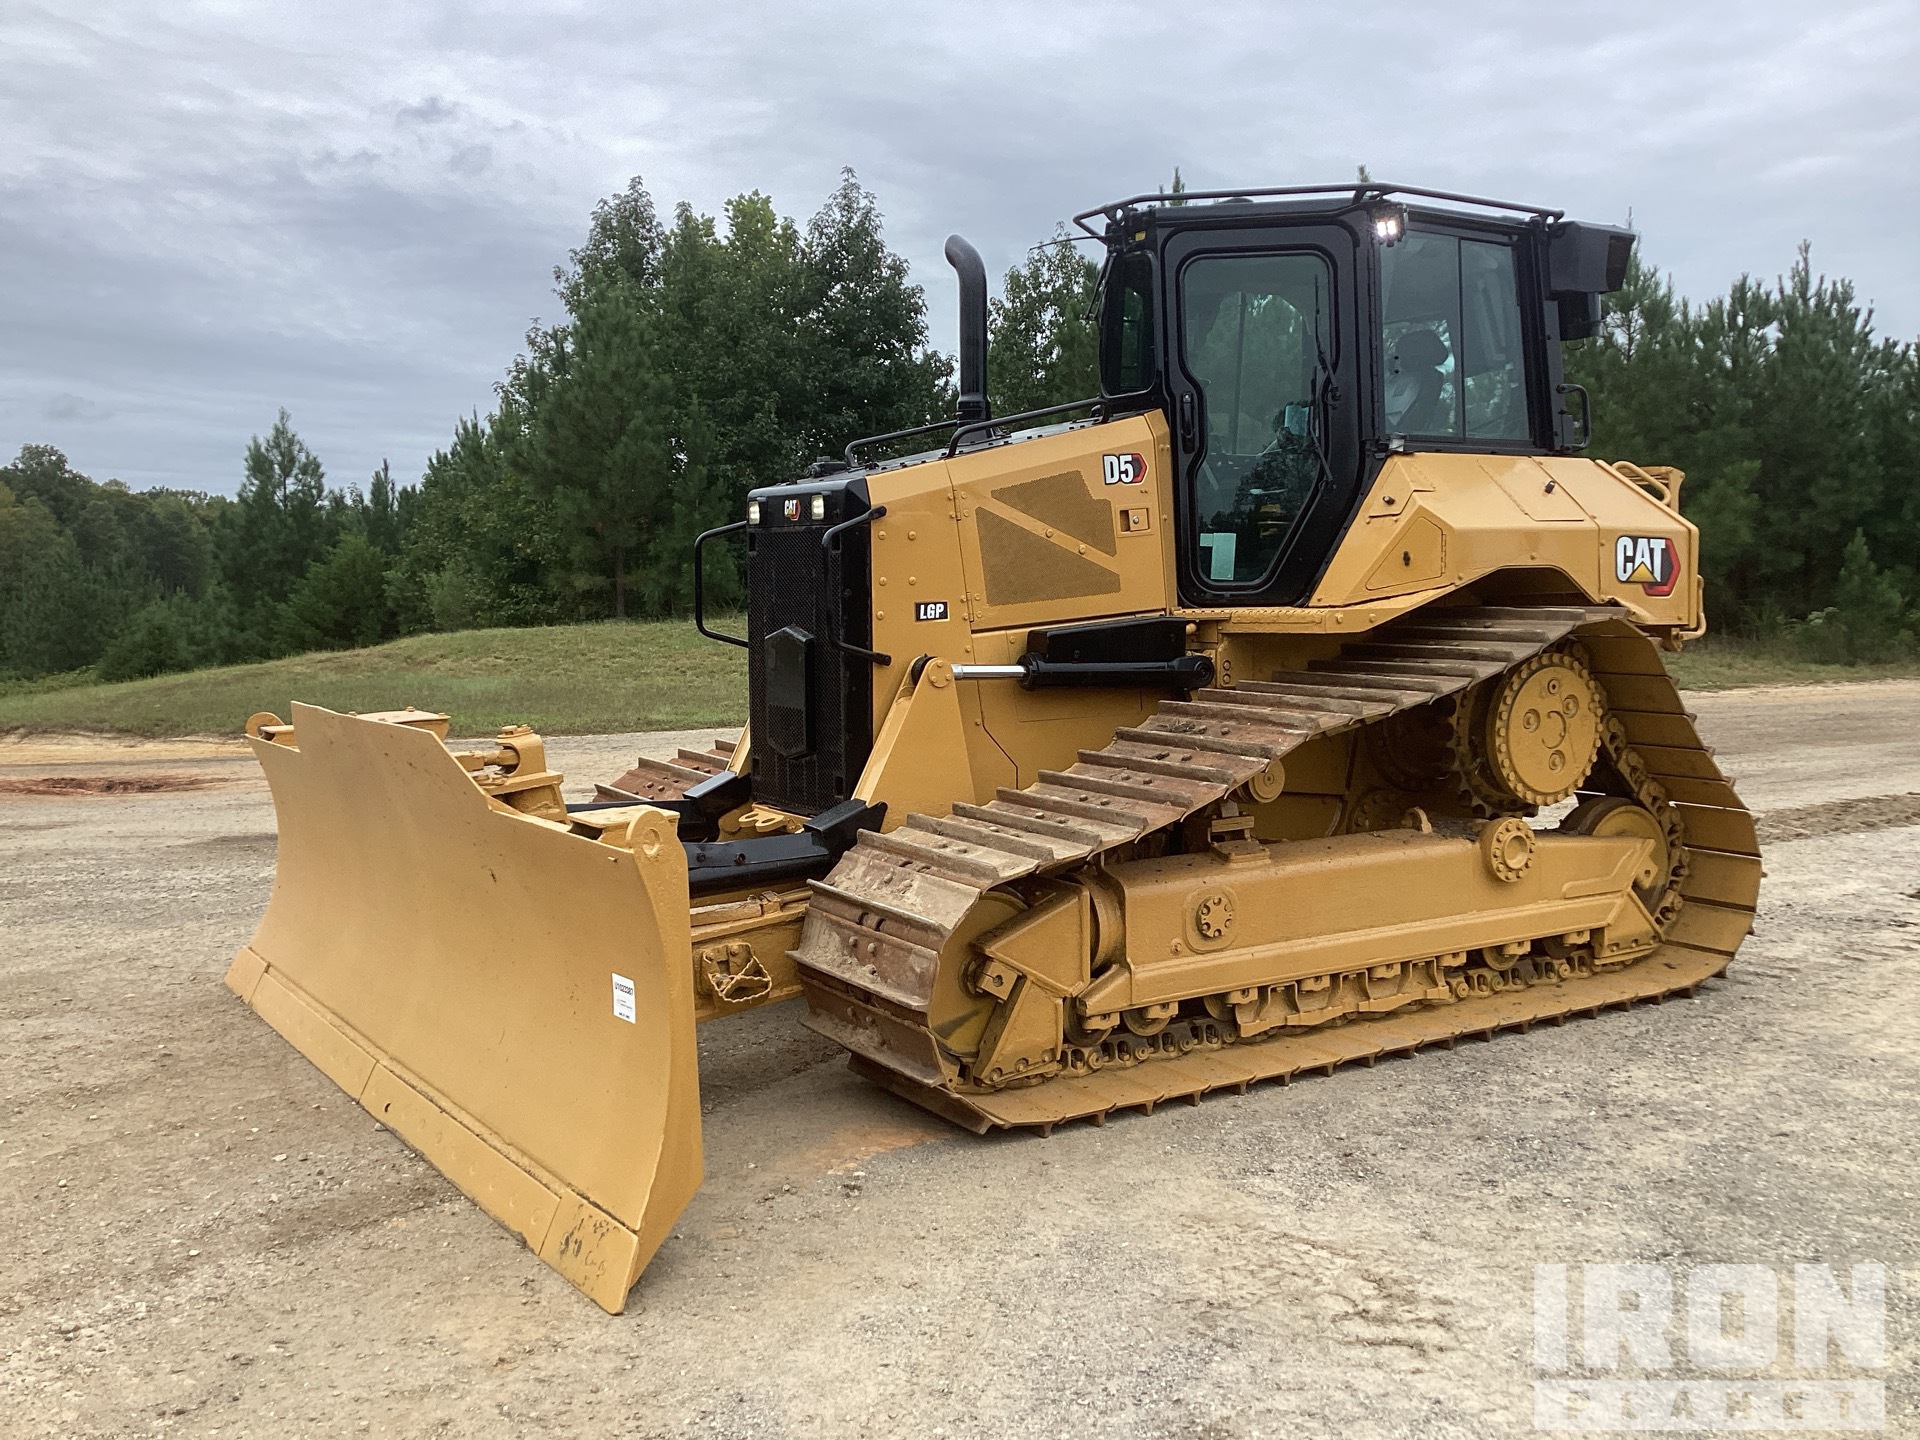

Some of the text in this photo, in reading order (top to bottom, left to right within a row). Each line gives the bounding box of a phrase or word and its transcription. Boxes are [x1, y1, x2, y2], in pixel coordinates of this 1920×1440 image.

[1103, 454, 1134, 484] D5
[784, 499, 797, 516] CAT
[1616, 536, 1666, 582] CAT
[920, 603, 945, 620] LGP
